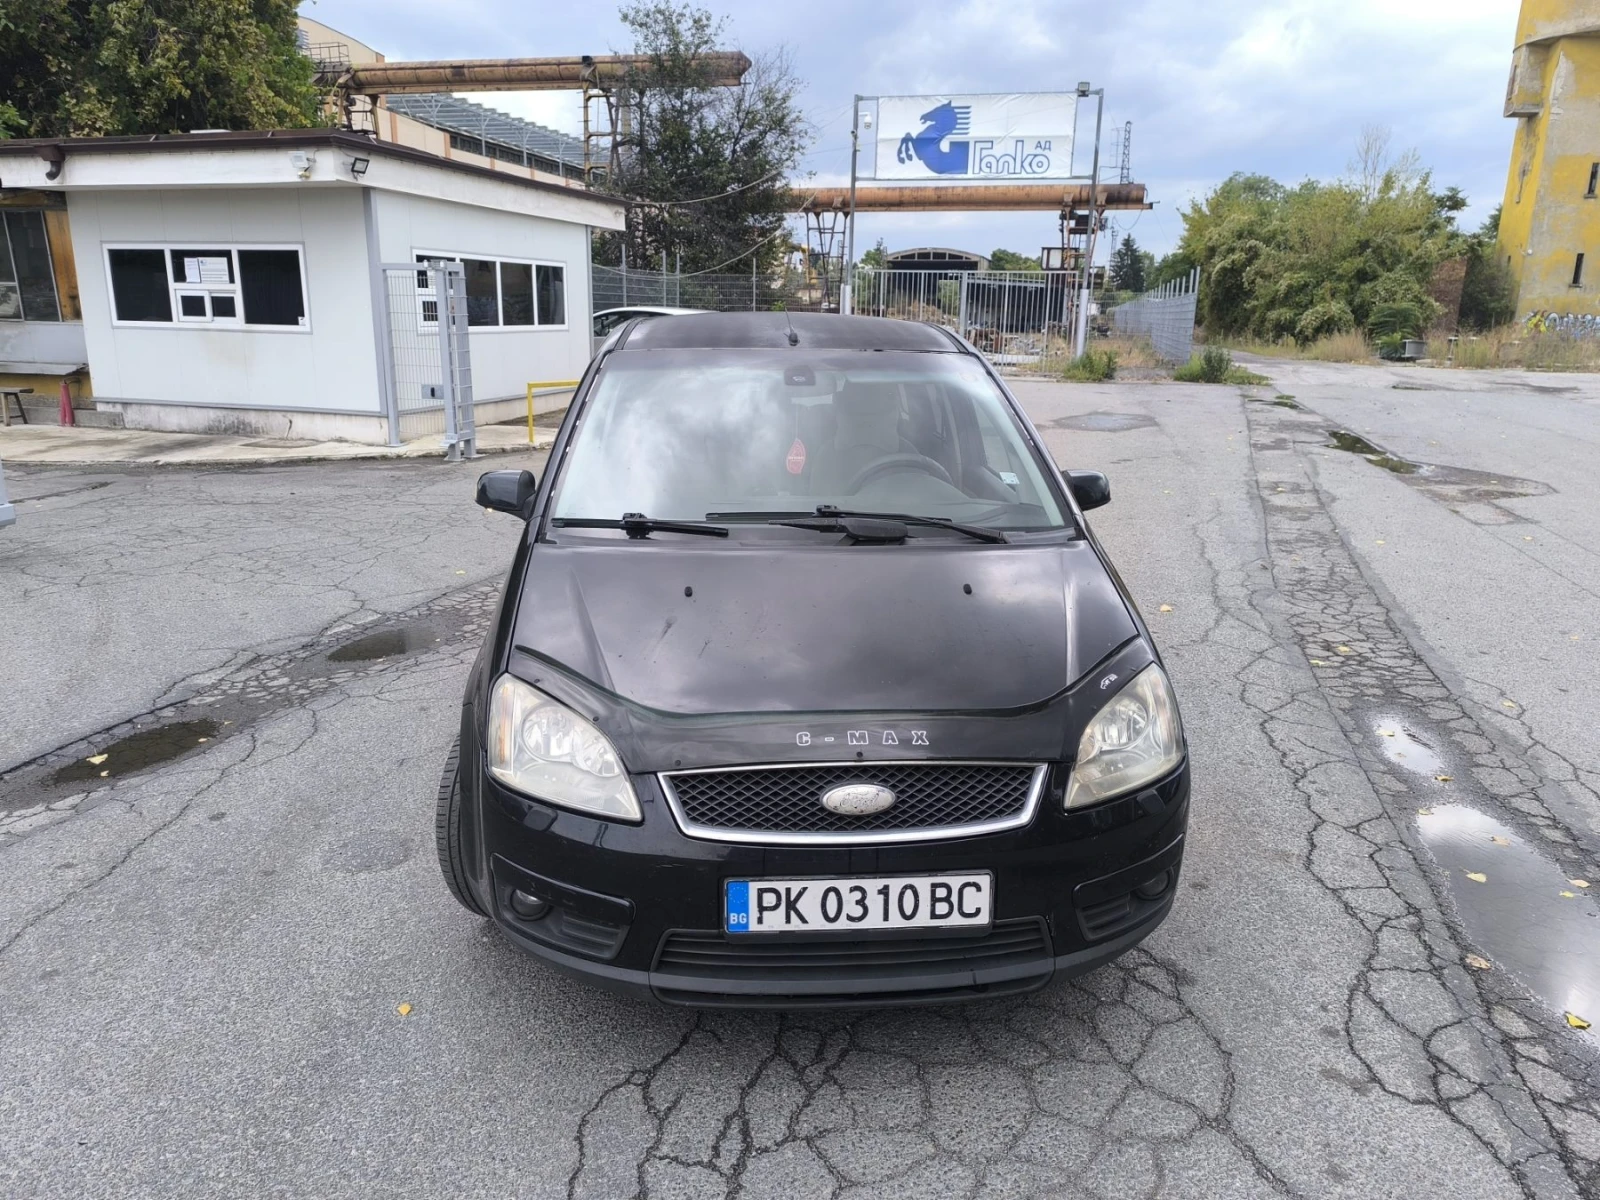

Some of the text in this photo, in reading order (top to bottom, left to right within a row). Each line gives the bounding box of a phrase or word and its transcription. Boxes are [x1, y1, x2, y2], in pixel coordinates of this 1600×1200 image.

[796, 731, 929, 746] C-MAX
[756, 881, 983, 925] PK 0310 BC
[729, 912, 748, 925] BG
